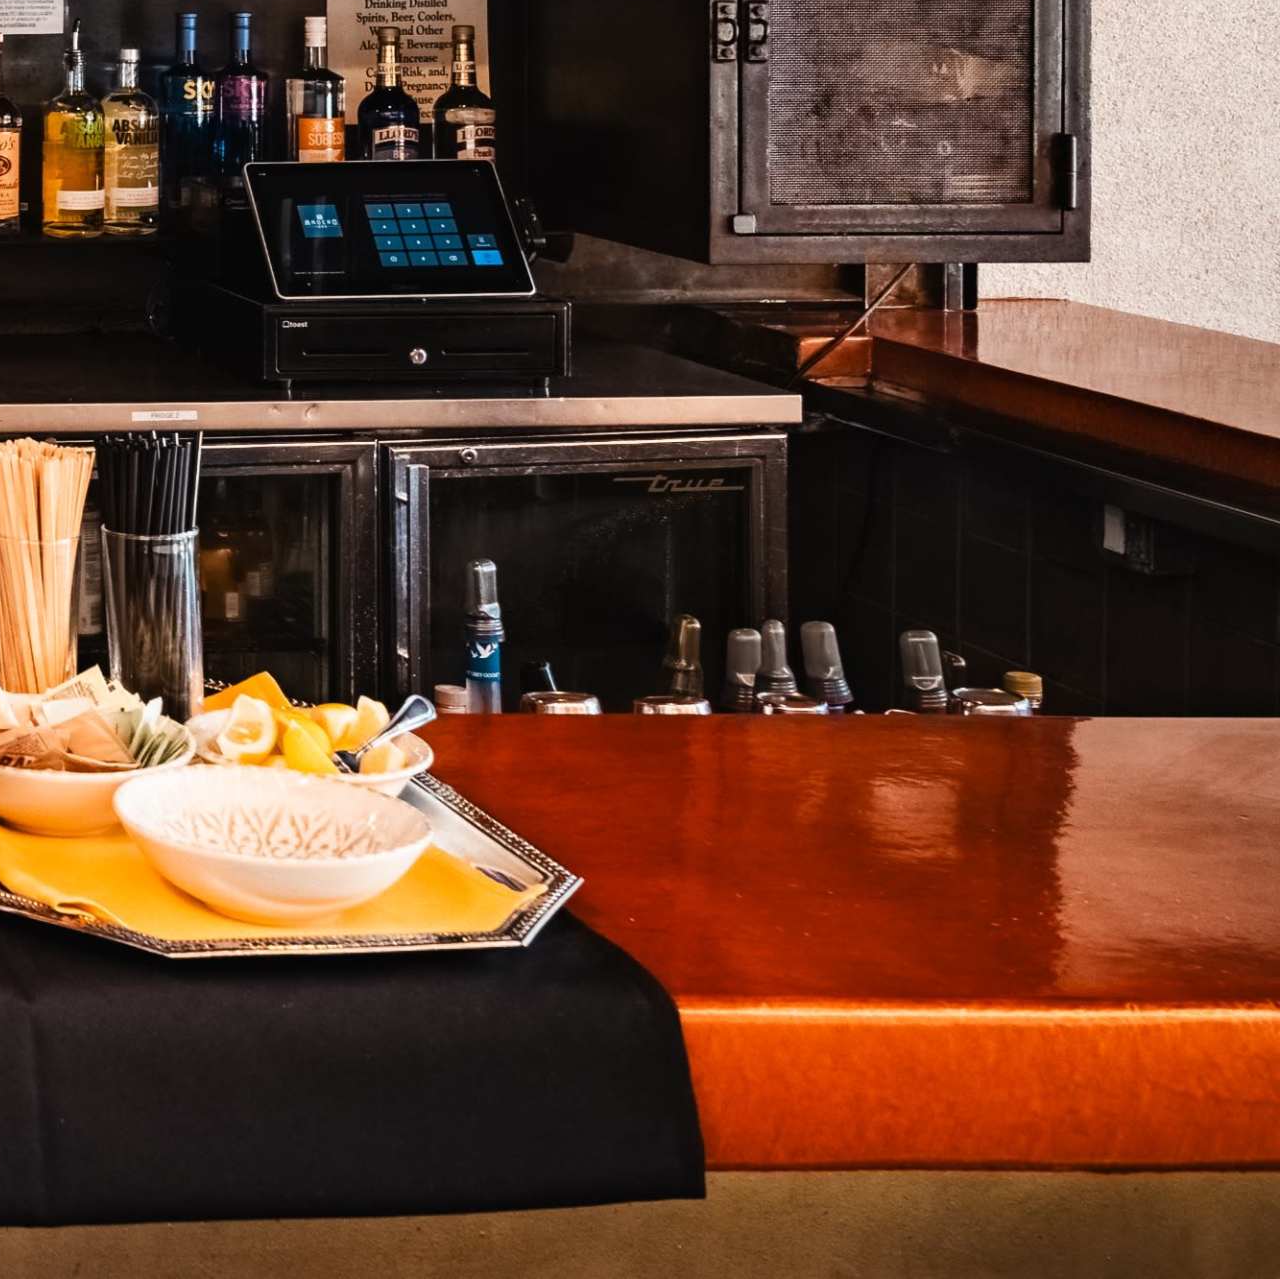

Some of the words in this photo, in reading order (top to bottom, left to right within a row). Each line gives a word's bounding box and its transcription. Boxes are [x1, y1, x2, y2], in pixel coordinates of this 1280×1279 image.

[356, 12, 389, 24] Spirits,
[391, 11, 415, 22] Beer,
[418, 11, 456, 22] Coolers,
[416, 25, 444, 35] Other
[400, 55, 438, 63] Increase
[400, 81, 450, 92] Pregnancy
[413, 97, 433, 105] ause
